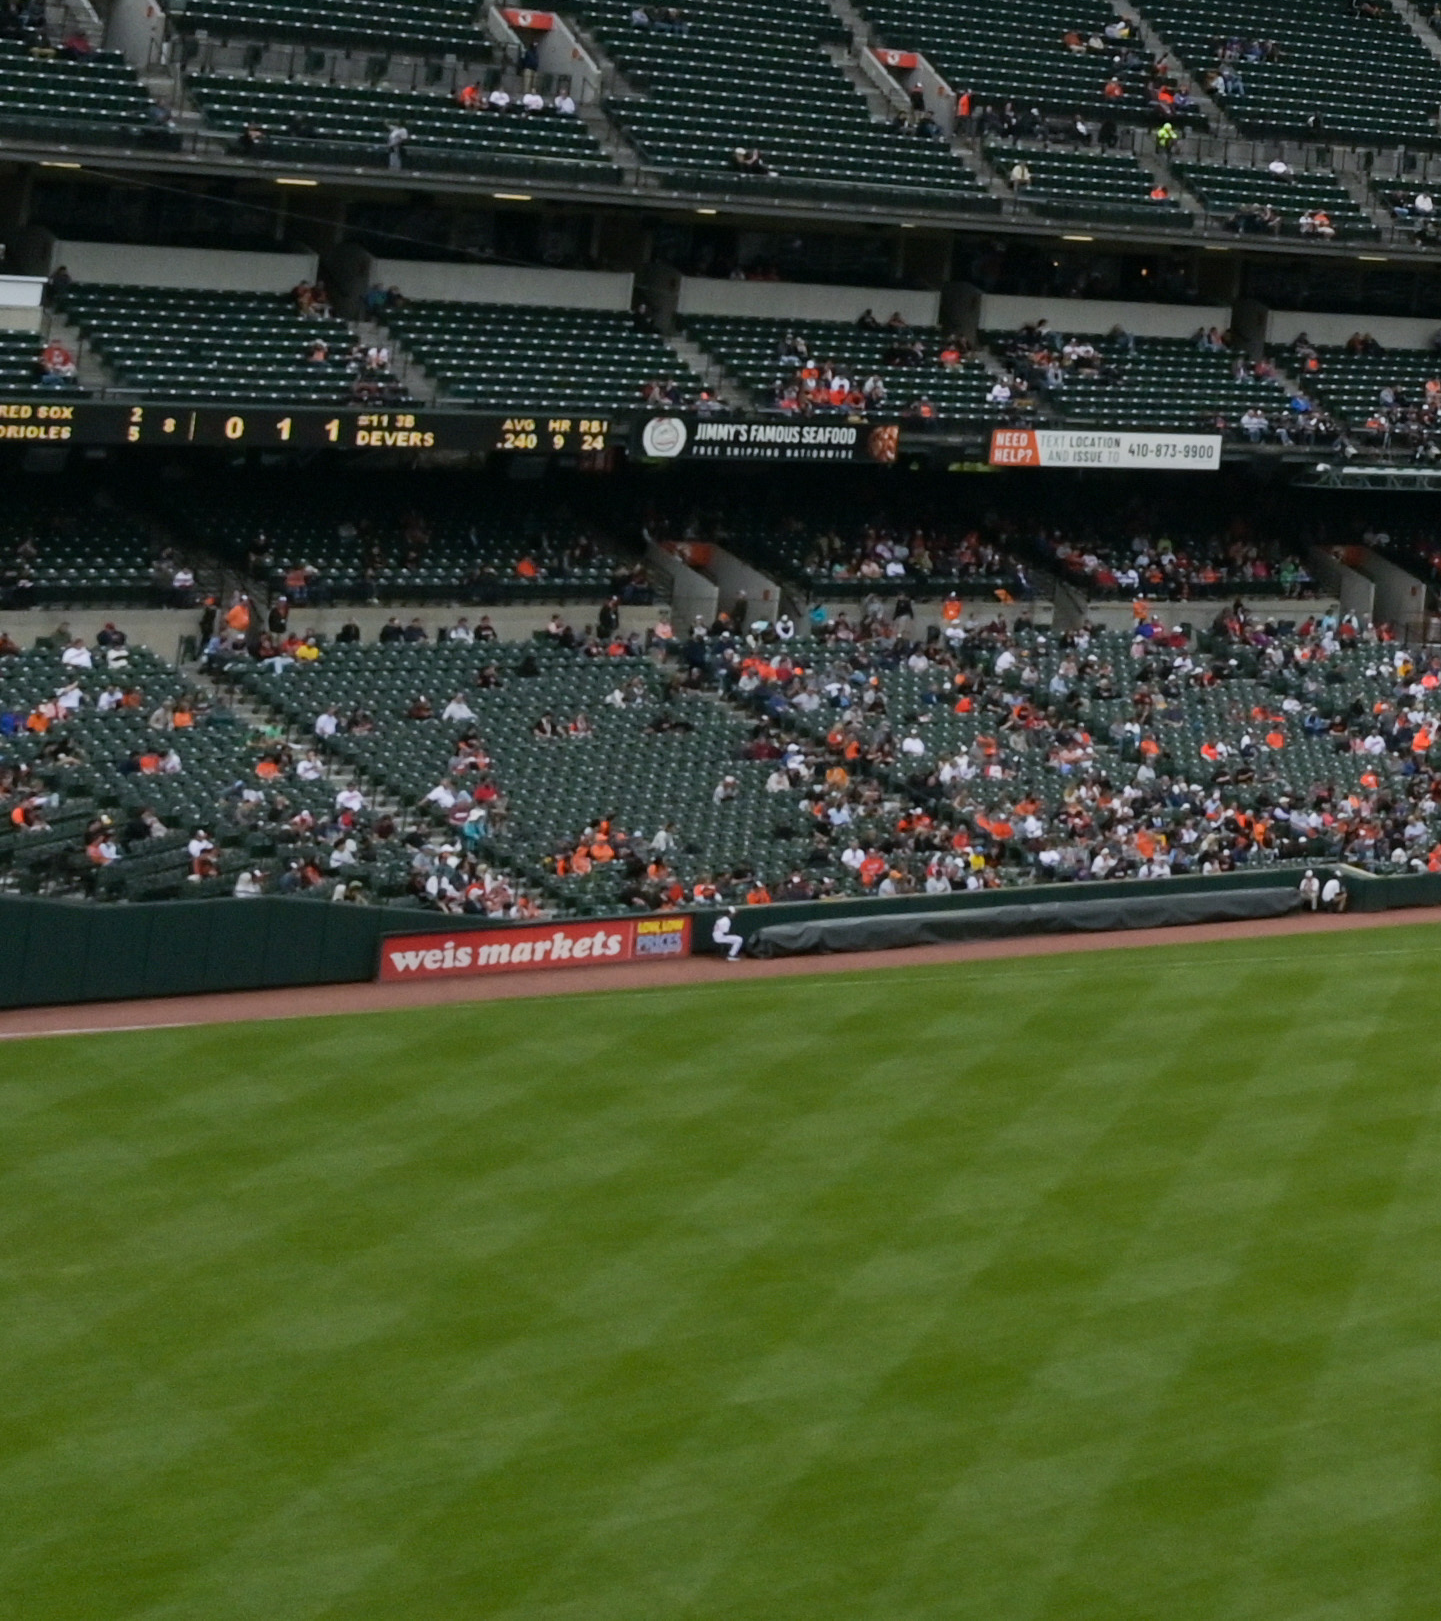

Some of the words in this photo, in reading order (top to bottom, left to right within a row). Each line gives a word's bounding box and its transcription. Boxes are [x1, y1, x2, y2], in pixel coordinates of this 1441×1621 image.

[37, 406, 74, 419] SOX
[131, 407, 143, 422] 2
[395, 415, 415, 427] 3B
[128, 426, 140, 442] 5
[225, 416, 244, 439] 0
[277, 418, 292, 440] 1
[325, 419, 340, 441] 1
[502, 419, 536, 431] AVG
[549, 420, 572, 432] HR
[579, 421, 608, 433] RBI
[695, 423, 748, 441] JIMMY'S
[750, 425, 800, 443] FAMOUS
[801, 427, 857, 445] SEAFOOD
[356, 431, 435, 447] DEVERS
[496, 433, 538, 449] .240
[553, 435, 565, 450] 9
[580, 436, 604, 450] 24
[996, 432, 1028, 447] NEED
[1041, 435, 1065, 448] TEXT
[1069, 436, 1121, 449] LOCATION
[994, 448, 1033, 463] HELP?
[1048, 449, 1069, 462] AND
[1073, 450, 1103, 463] ISSUE
[1107, 451, 1120, 463] TO
[1127, 442, 1214, 459] 410-873-9900
[390, 941, 472, 972] weis
[477, 931, 622, 966] markets
[636, 933, 683, 955] PRICES
